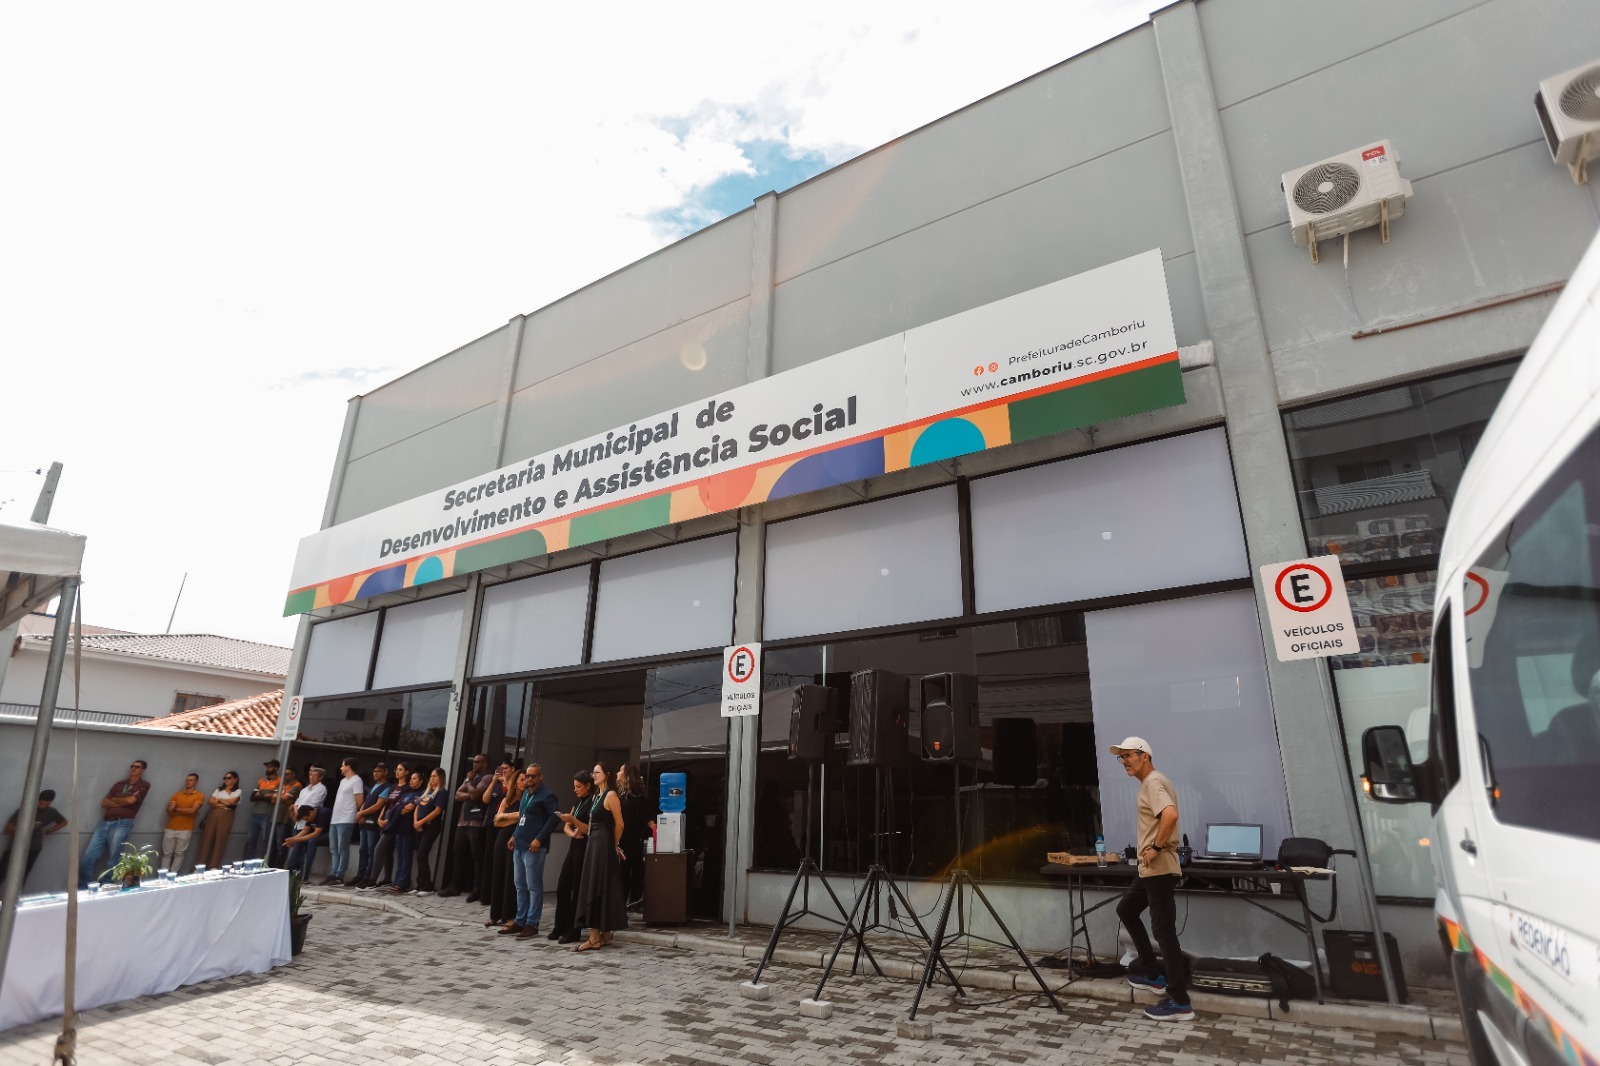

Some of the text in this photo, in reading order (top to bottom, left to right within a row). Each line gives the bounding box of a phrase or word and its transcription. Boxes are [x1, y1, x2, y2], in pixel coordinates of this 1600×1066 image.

[1008, 319, 1146, 365] PrefeituradeCamboriu
[960, 339, 1148, 397] www.camboriu.sc.gov.br
[442, 400, 735, 511] Secretaria Municipal de
[379, 395, 857, 558] Desenvolvimento e Assistência Social
[1290, 573, 1314, 603] E
[1283, 622, 1344, 638] VEÍCULOS
[1290, 638, 1343, 653] OFICIAIS
[736, 655, 745, 676] E
